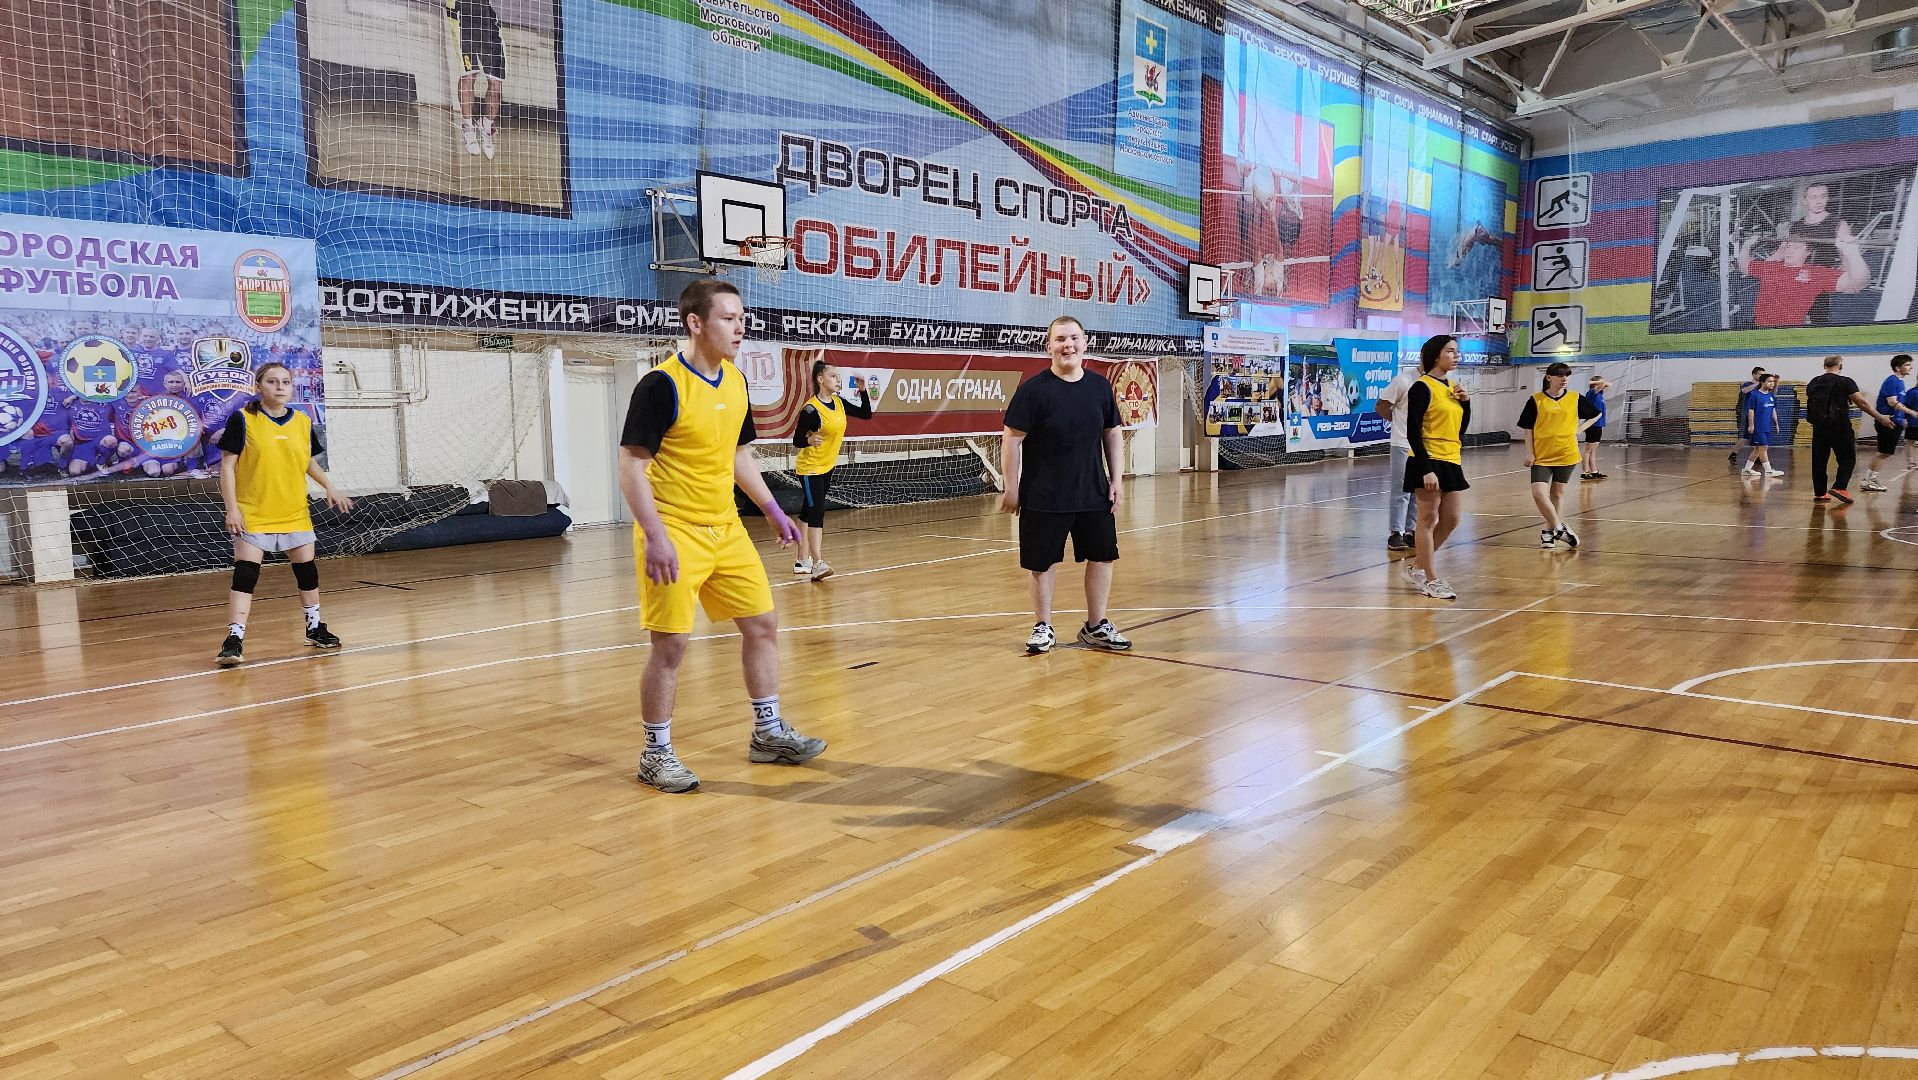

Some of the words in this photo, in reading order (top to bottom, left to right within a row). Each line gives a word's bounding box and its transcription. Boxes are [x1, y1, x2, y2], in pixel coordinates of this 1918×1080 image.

[698, 0, 780, 23] вительство
[700, 7, 771, 38] Московской
[712, 31, 760, 51] области
[1318, 64, 1360, 90] БУДУЩЕЕ
[1418, 104, 1454, 128] ДИНАМИКА
[776, 133, 982, 219] ДВОРЕЦ
[994, 177, 1134, 239] СПОРТА
[0, 268, 180, 301] ФУТБОЛА
[319, 286, 590, 324] ДОСТИЖЕНИЯ
[782, 315, 870, 341] РЕКОРД
[890, 323, 983, 345] БУДУЩЕЕ
[998, 329, 1048, 346] СПОРТ
[1104, 336, 1178, 353] ДИНАМИКА
[896, 378, 942, 404] ОДНА
[946, 378, 1006, 403] СТРАНА,
[754, 706, 774, 719] 23
